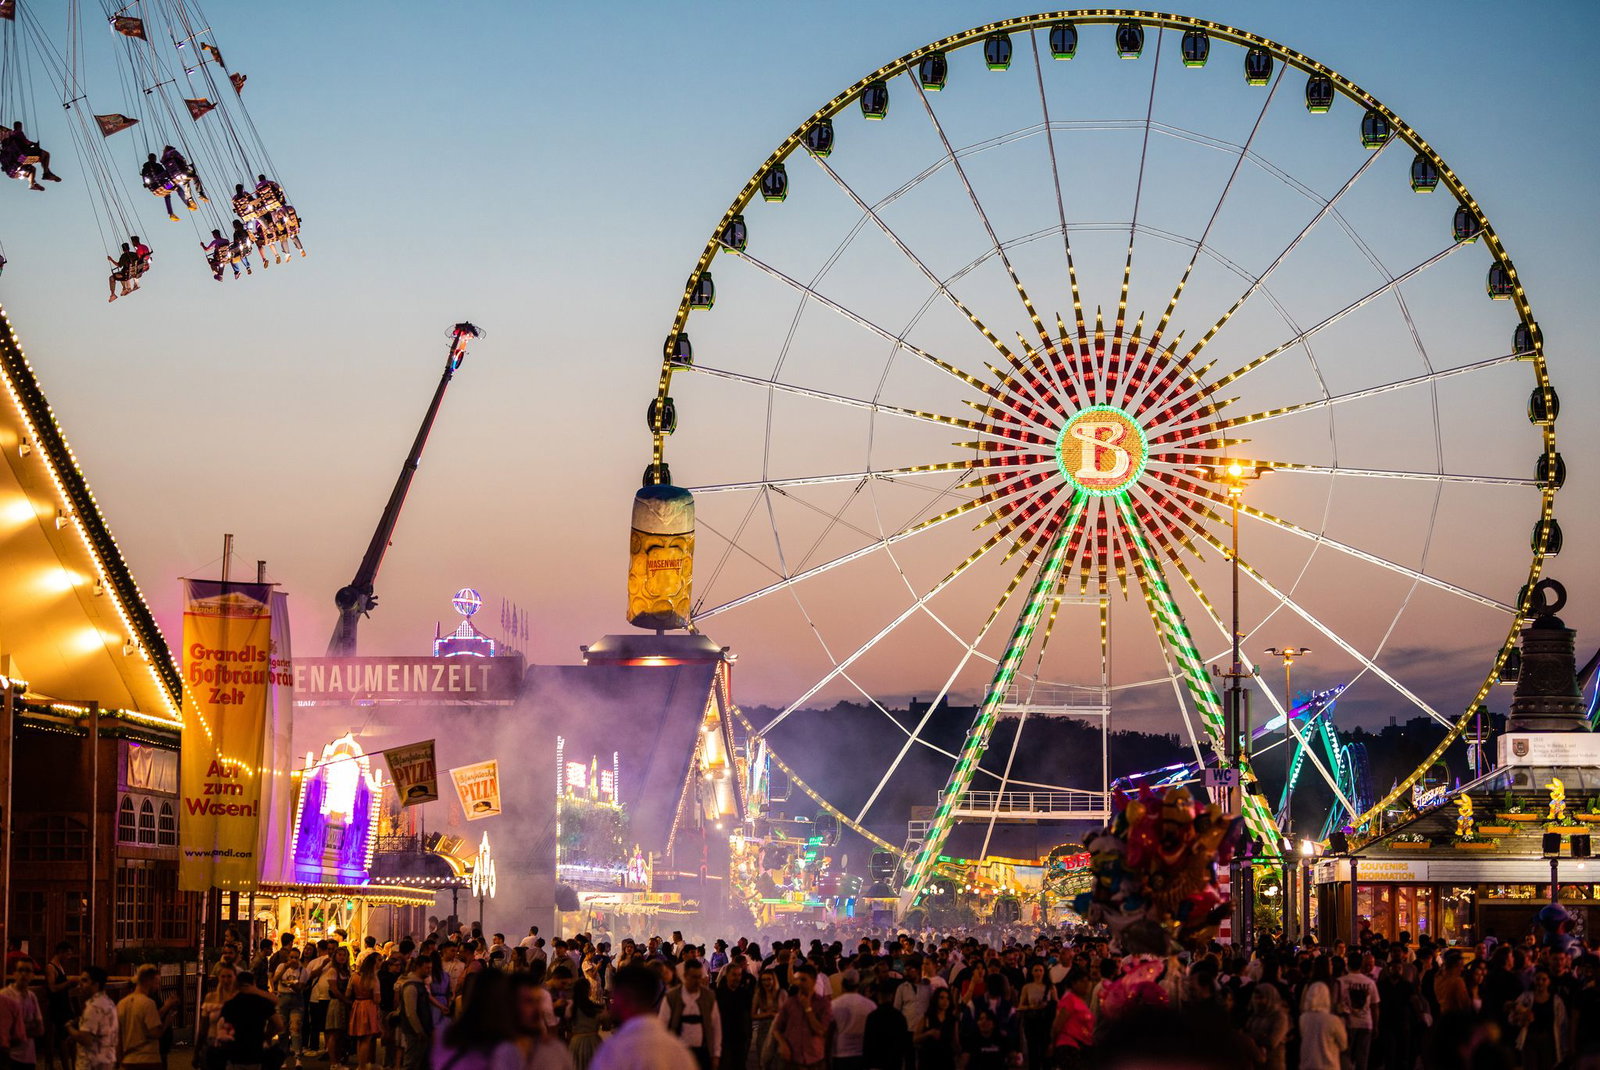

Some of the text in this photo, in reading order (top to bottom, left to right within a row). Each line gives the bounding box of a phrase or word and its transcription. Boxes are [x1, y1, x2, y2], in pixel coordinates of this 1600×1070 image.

[1071, 422, 1131, 482] B
[190, 643, 267, 662] Grandls
[190, 662, 265, 686] Hofbräu
[294, 664, 492, 692] ENAUMEINZELT
[209, 688, 245, 705] Zelt
[395, 760, 437, 788] PIZZA
[1213, 769, 1231, 781] WC
[203, 783, 243, 795] zum
[459, 779, 498, 803] PIZZA
[185, 798, 258, 817] Wasen!
[1357, 872, 1415, 880] NFORMATION
